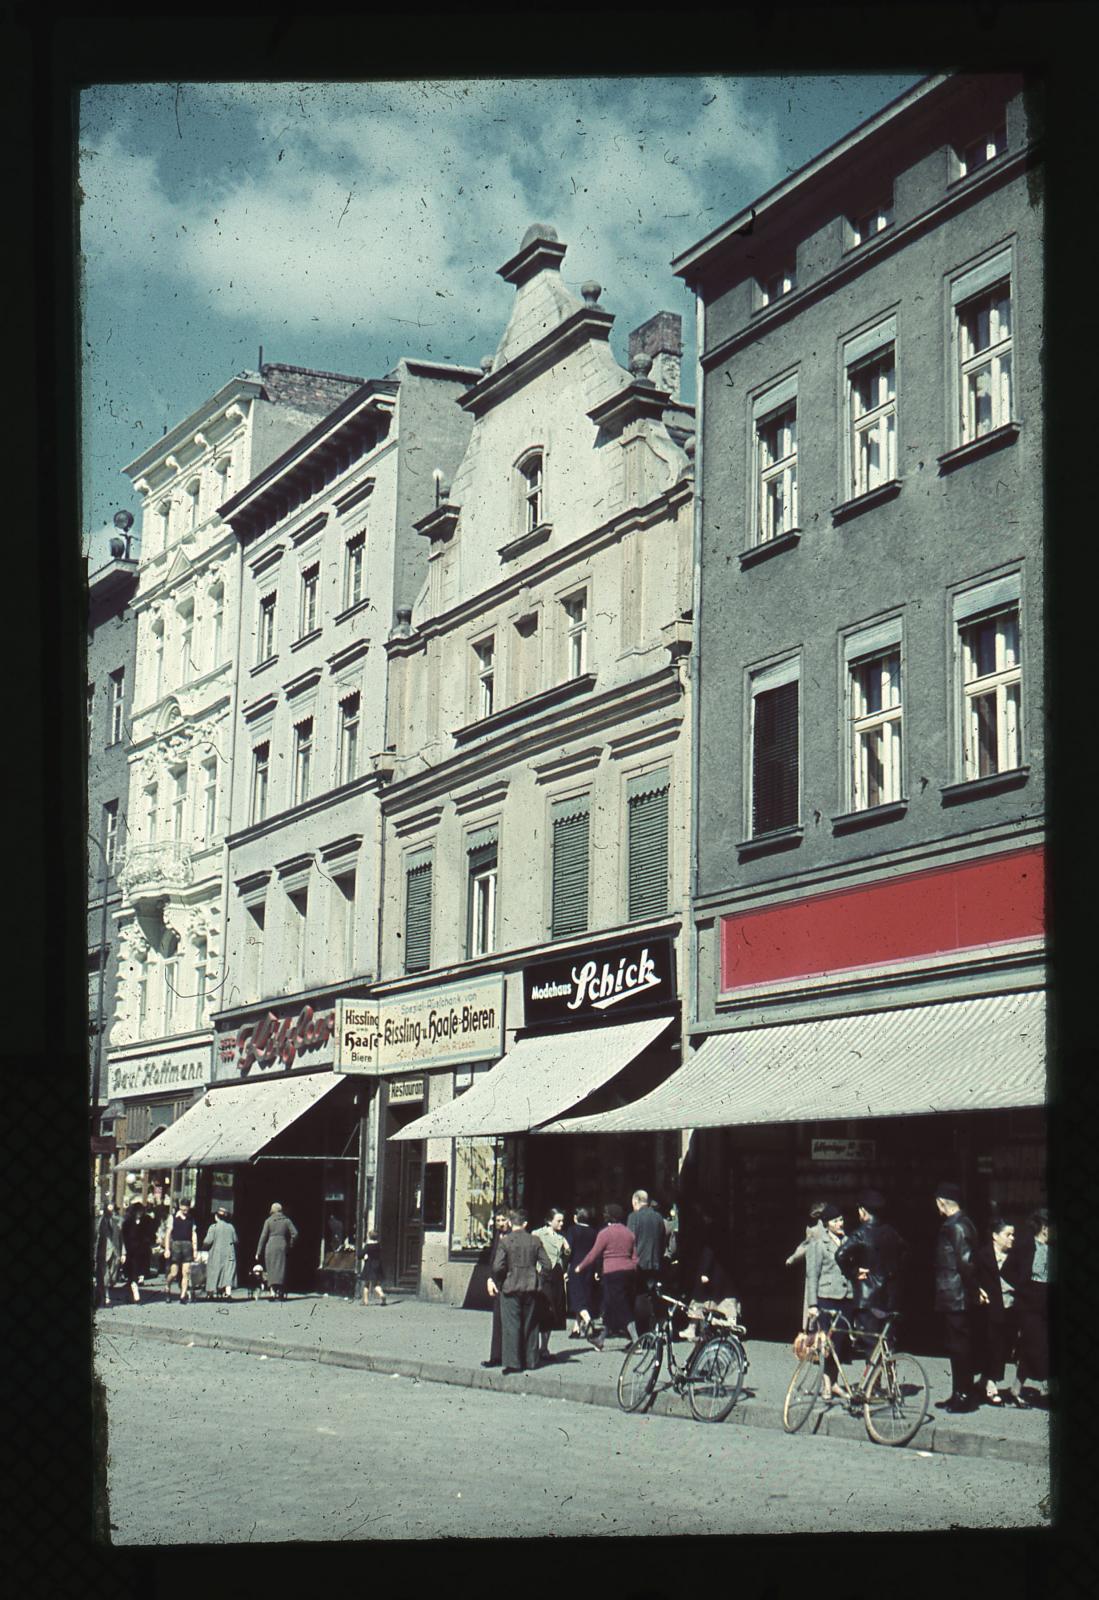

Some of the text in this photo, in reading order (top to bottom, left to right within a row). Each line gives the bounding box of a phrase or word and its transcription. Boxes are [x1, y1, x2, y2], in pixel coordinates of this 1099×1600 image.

[531, 948, 661, 1009] Modehaus Schick
[346, 1009, 379, 1029] Kissling
[384, 1018, 421, 1047] Kissling
[351, 1052, 373, 1062] Biere
